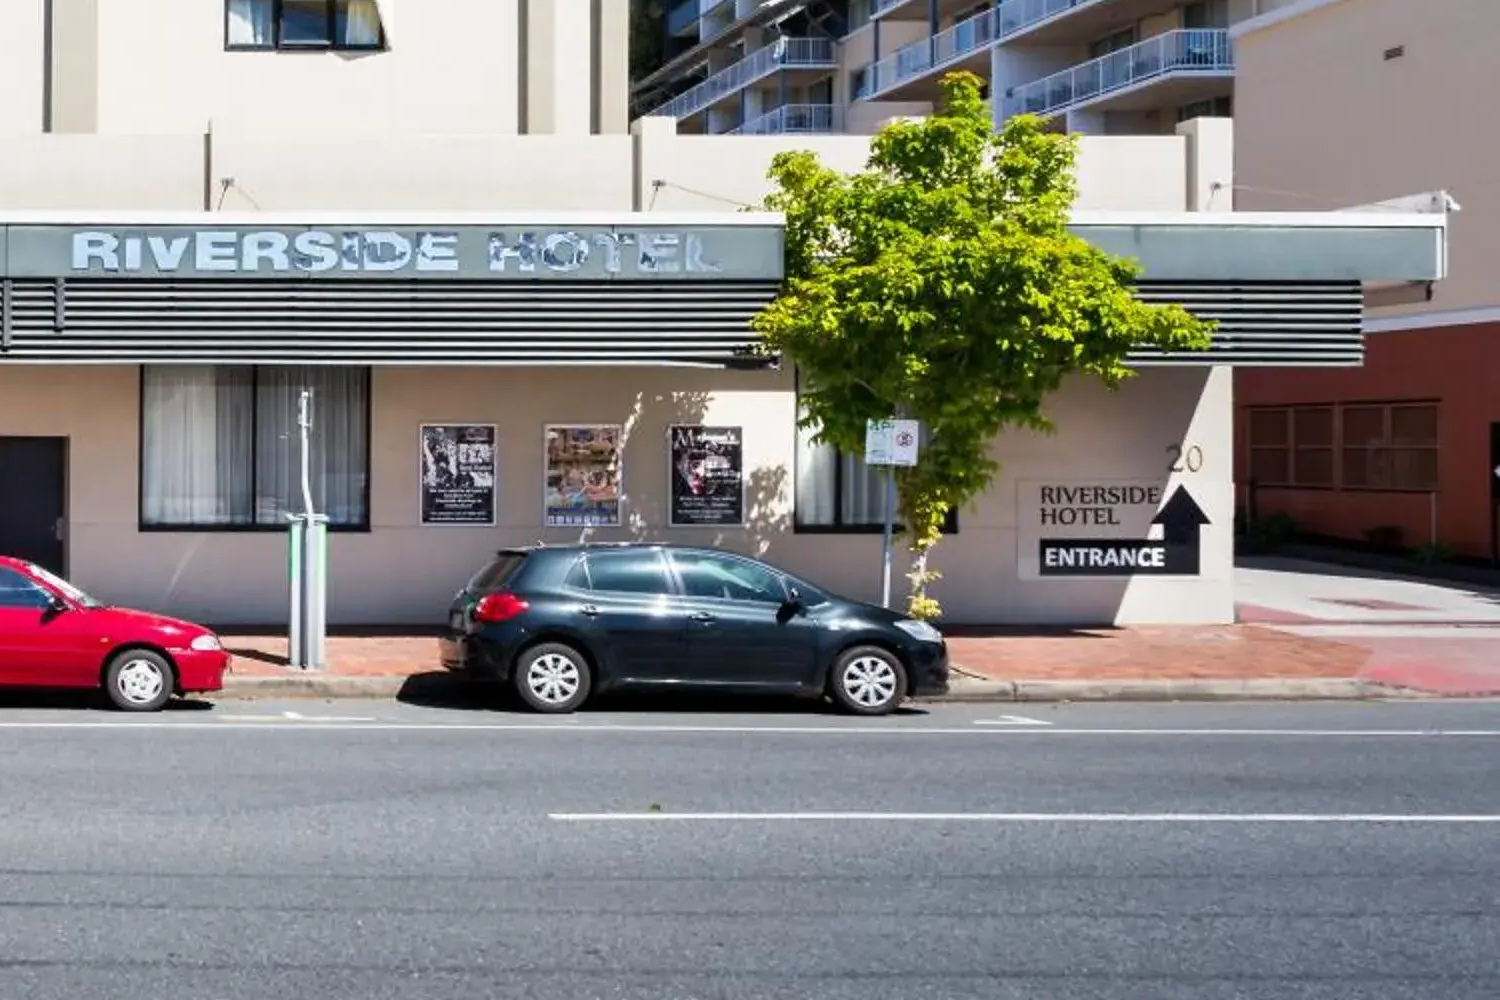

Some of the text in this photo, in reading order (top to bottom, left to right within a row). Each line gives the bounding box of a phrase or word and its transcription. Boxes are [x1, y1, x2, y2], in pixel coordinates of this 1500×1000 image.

[71, 231, 723, 272] RIVERSIDE HOTEL
[1166, 444, 1204, 473] 20
[1039, 486, 1161, 505] RIVERSIDE
[1039, 507, 1121, 526] HOTEL
[1044, 547, 1166, 567] ENTRANCE
